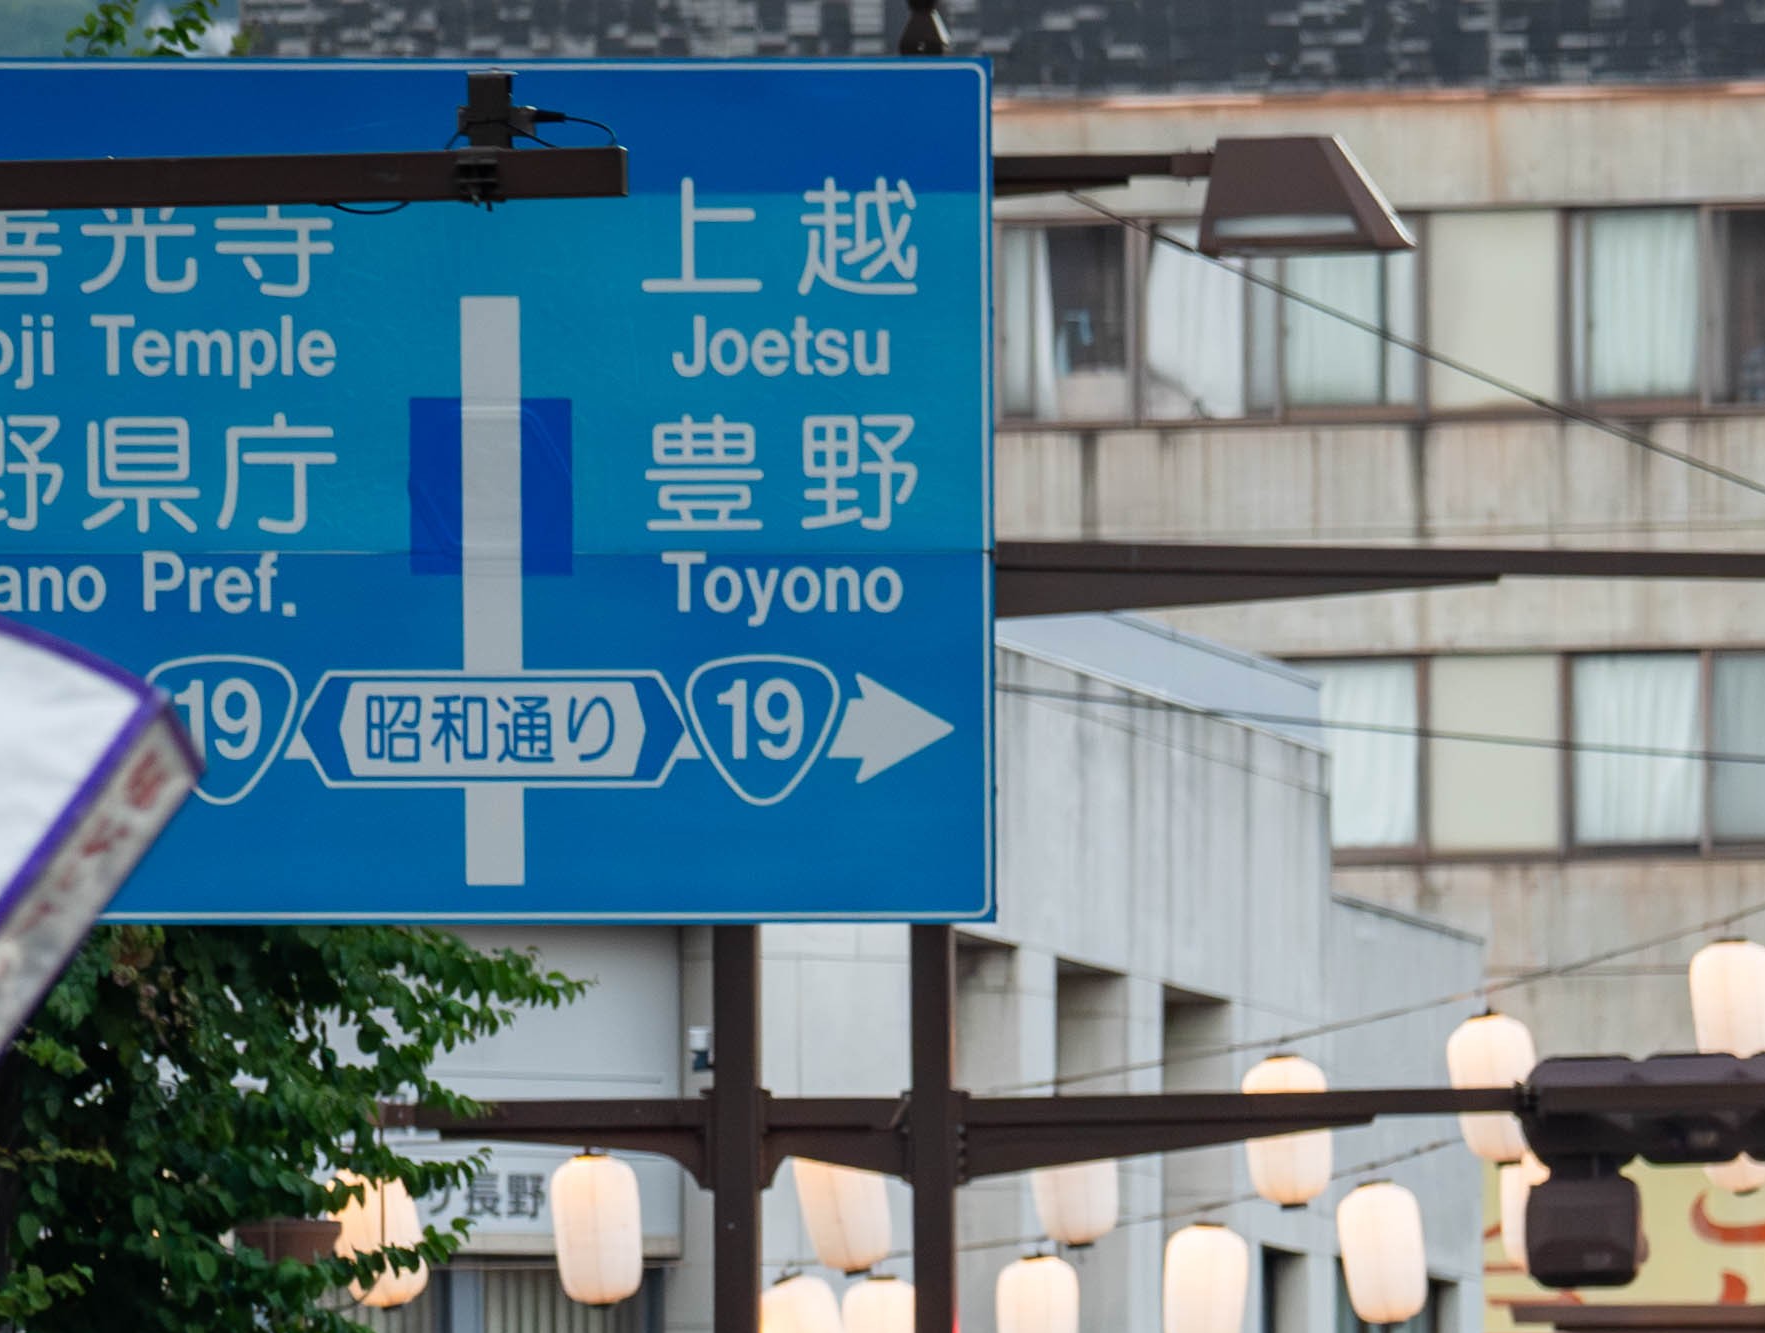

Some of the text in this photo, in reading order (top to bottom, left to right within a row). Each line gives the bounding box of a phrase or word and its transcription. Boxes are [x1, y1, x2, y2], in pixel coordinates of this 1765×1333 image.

[642, 178, 918, 296] 上越
[90, 314, 337, 389] Temple
[672, 315, 891, 378] Joetsu
[644, 414, 918, 532] 豊野
[142, 549, 297, 617] Pref.
[662, 551, 905, 628] Toyono
[174, 679, 262, 760] 19
[365, 693, 616, 765] 昭和通り
[716, 679, 805, 760] 19
